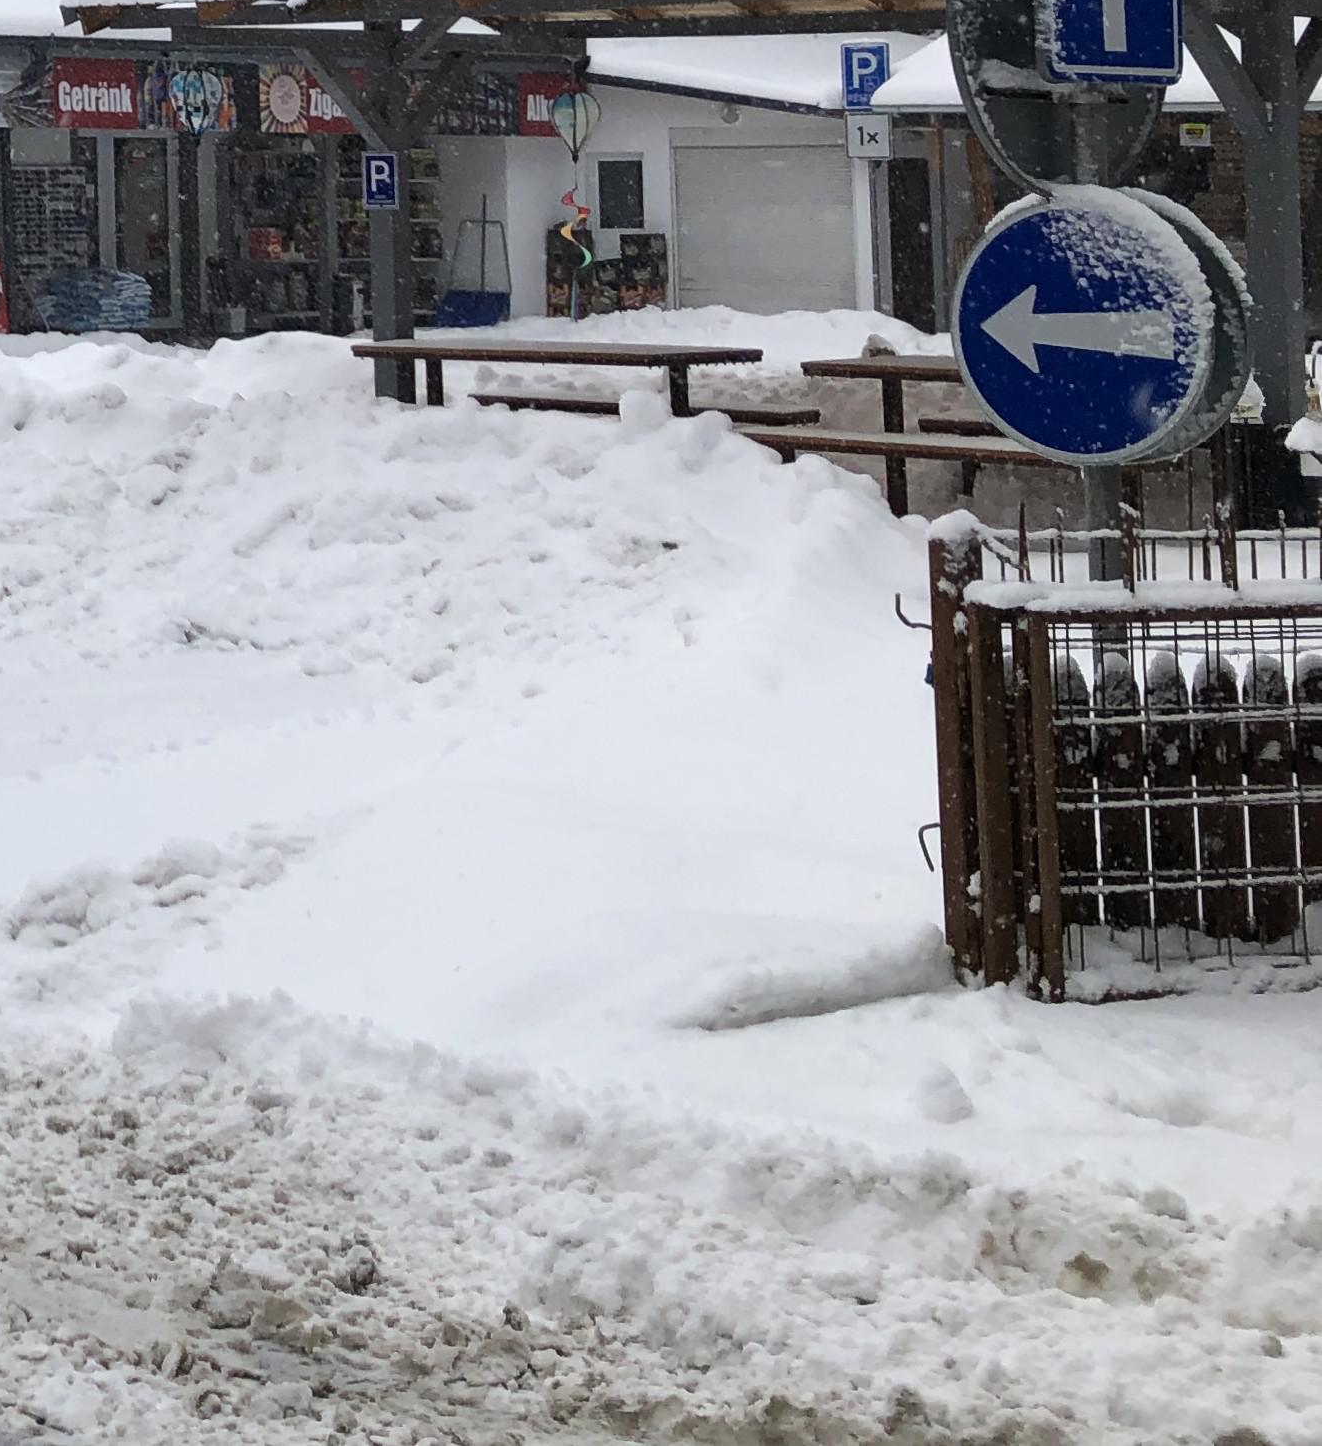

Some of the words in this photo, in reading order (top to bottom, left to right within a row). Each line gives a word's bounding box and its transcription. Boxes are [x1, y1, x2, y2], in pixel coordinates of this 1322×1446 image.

[852, 52, 877, 89] P
[58, 80, 133, 113] Getränk
[308, 86, 347, 121] Ziga
[857, 125, 879, 146] 1x
[370, 160, 390, 192] P
